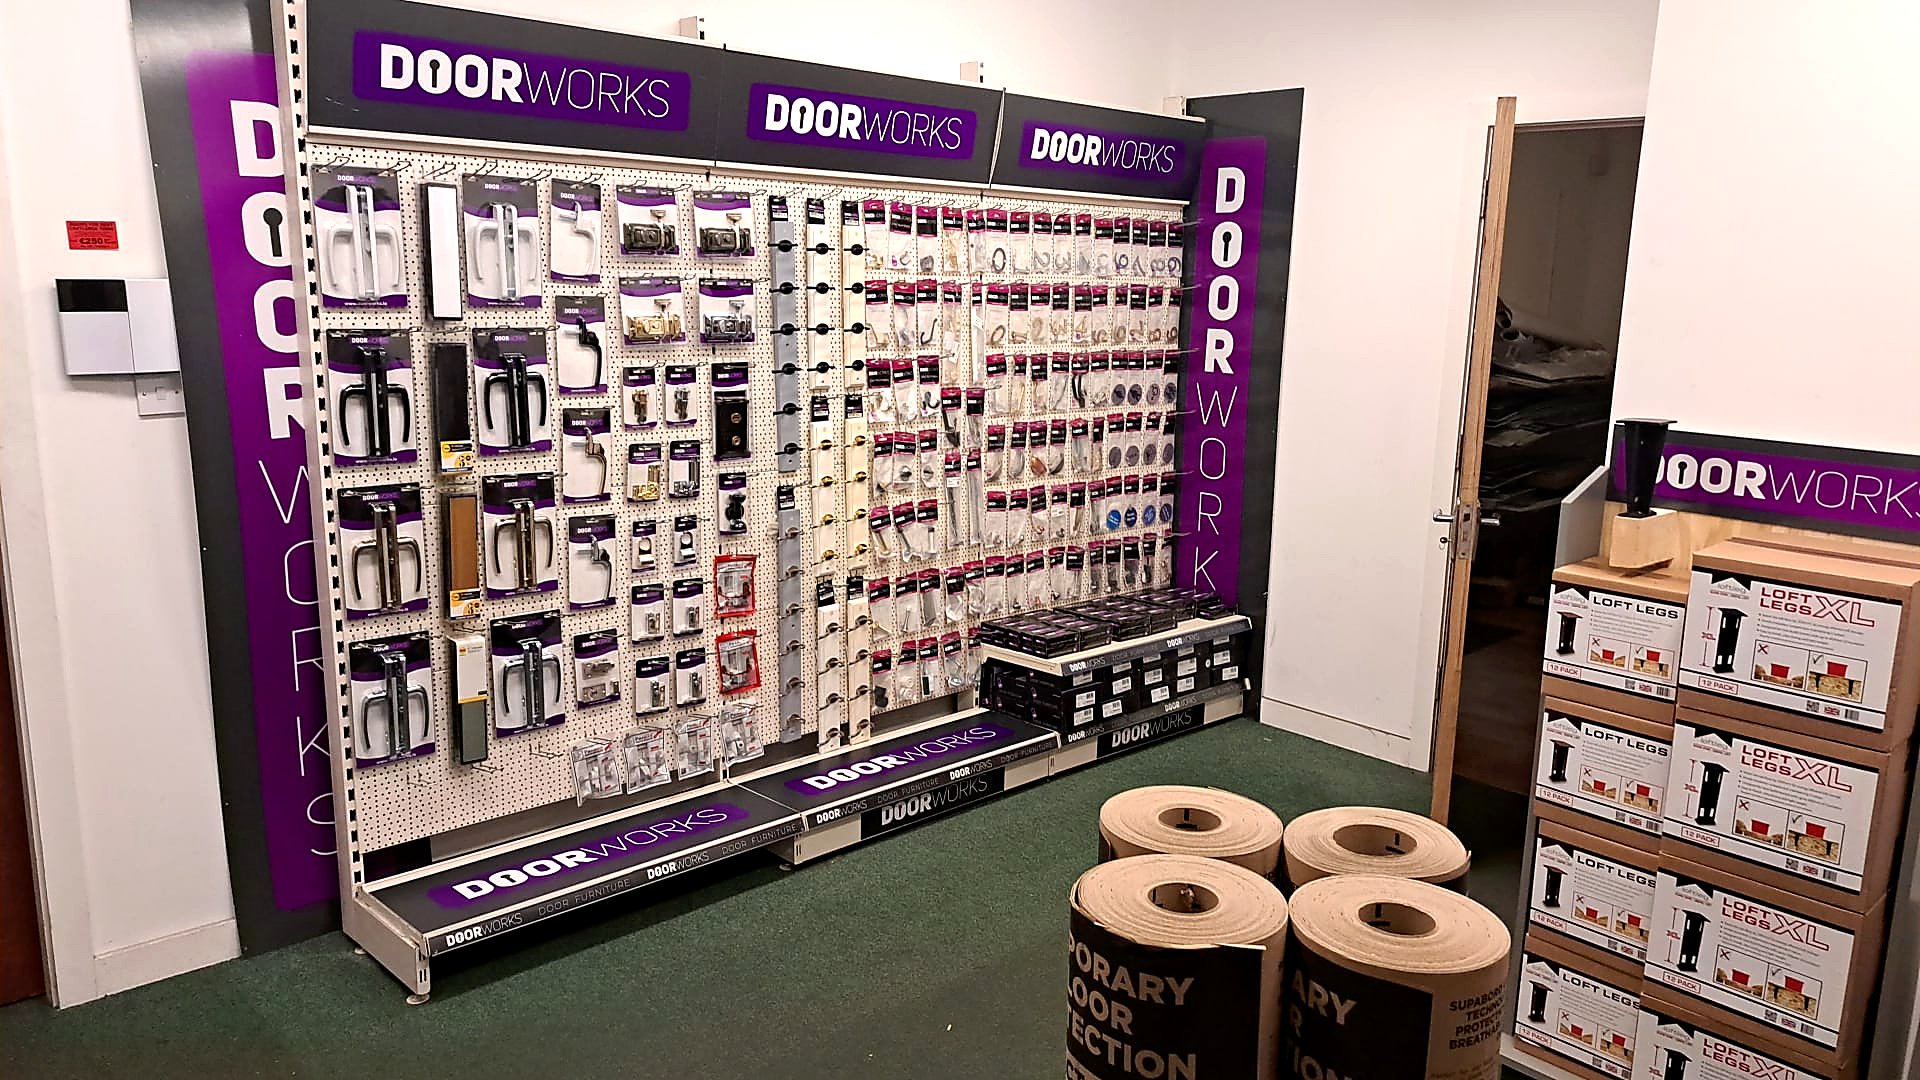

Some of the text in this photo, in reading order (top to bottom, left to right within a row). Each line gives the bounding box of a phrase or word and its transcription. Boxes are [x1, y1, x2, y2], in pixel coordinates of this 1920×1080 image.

[380, 43, 670, 118] DOORWORKS
[765, 93, 962, 151] DOORWORKS
[1031, 128, 1175, 174] DOORWORKS
[1193, 166, 1246, 590] DOORWORK
[1655, 453, 1920, 519] OORWORK
[1593, 596, 1679, 619] LOFT LEGS
[1759, 598, 1812, 616] LEGS
[1761, 586, 1875, 628] LOFT XL
[1559, 665, 1579, 675] PACK
[1701, 679, 1735, 692] 12 PACK
[1111, 711, 1192, 748] DOORWORKS
[1585, 727, 1668, 757] LOFT LEGS
[803, 727, 997, 790] DOORWORKS
[1741, 756, 1791, 776] LEGS
[1742, 744, 1792, 764] LOFT
[1791, 757, 1852, 793] XL
[816, 799, 868, 824] DOORWORKS
[949, 759, 993, 781] DOORWORKS
[881, 775, 988, 826] DOORWORKS
[1552, 792, 1570, 803] PACK
[452, 808, 728, 901] DOORWORKS
[1684, 829, 1717, 844] 12 PACK
[445, 823, 797, 947] DOORWORKS DOOR FURNITURE DOORWORKS DOOR FURNITURE
[1577, 855, 1615, 874] LOFT
[1618, 868, 1657, 889] LEGS
[1546, 916, 1564, 928] PACK
[1722, 906, 1771, 931] LEGS
[1723, 896, 1772, 919] LOFT
[1771, 913, 1829, 951] XL
[1562, 973, 1600, 993] LOFT
[1603, 988, 1640, 1010] LEGS
[1666, 974, 1697, 990] 12 PACK
[1067, 975, 1133, 1036] OOR
[1068, 1005, 1197, 1080] ECTION
[1531, 1032, 1549, 1044] PACK
[1703, 1038, 1750, 1062] LOFT
[1702, 1048, 1750, 1073] LEGS
